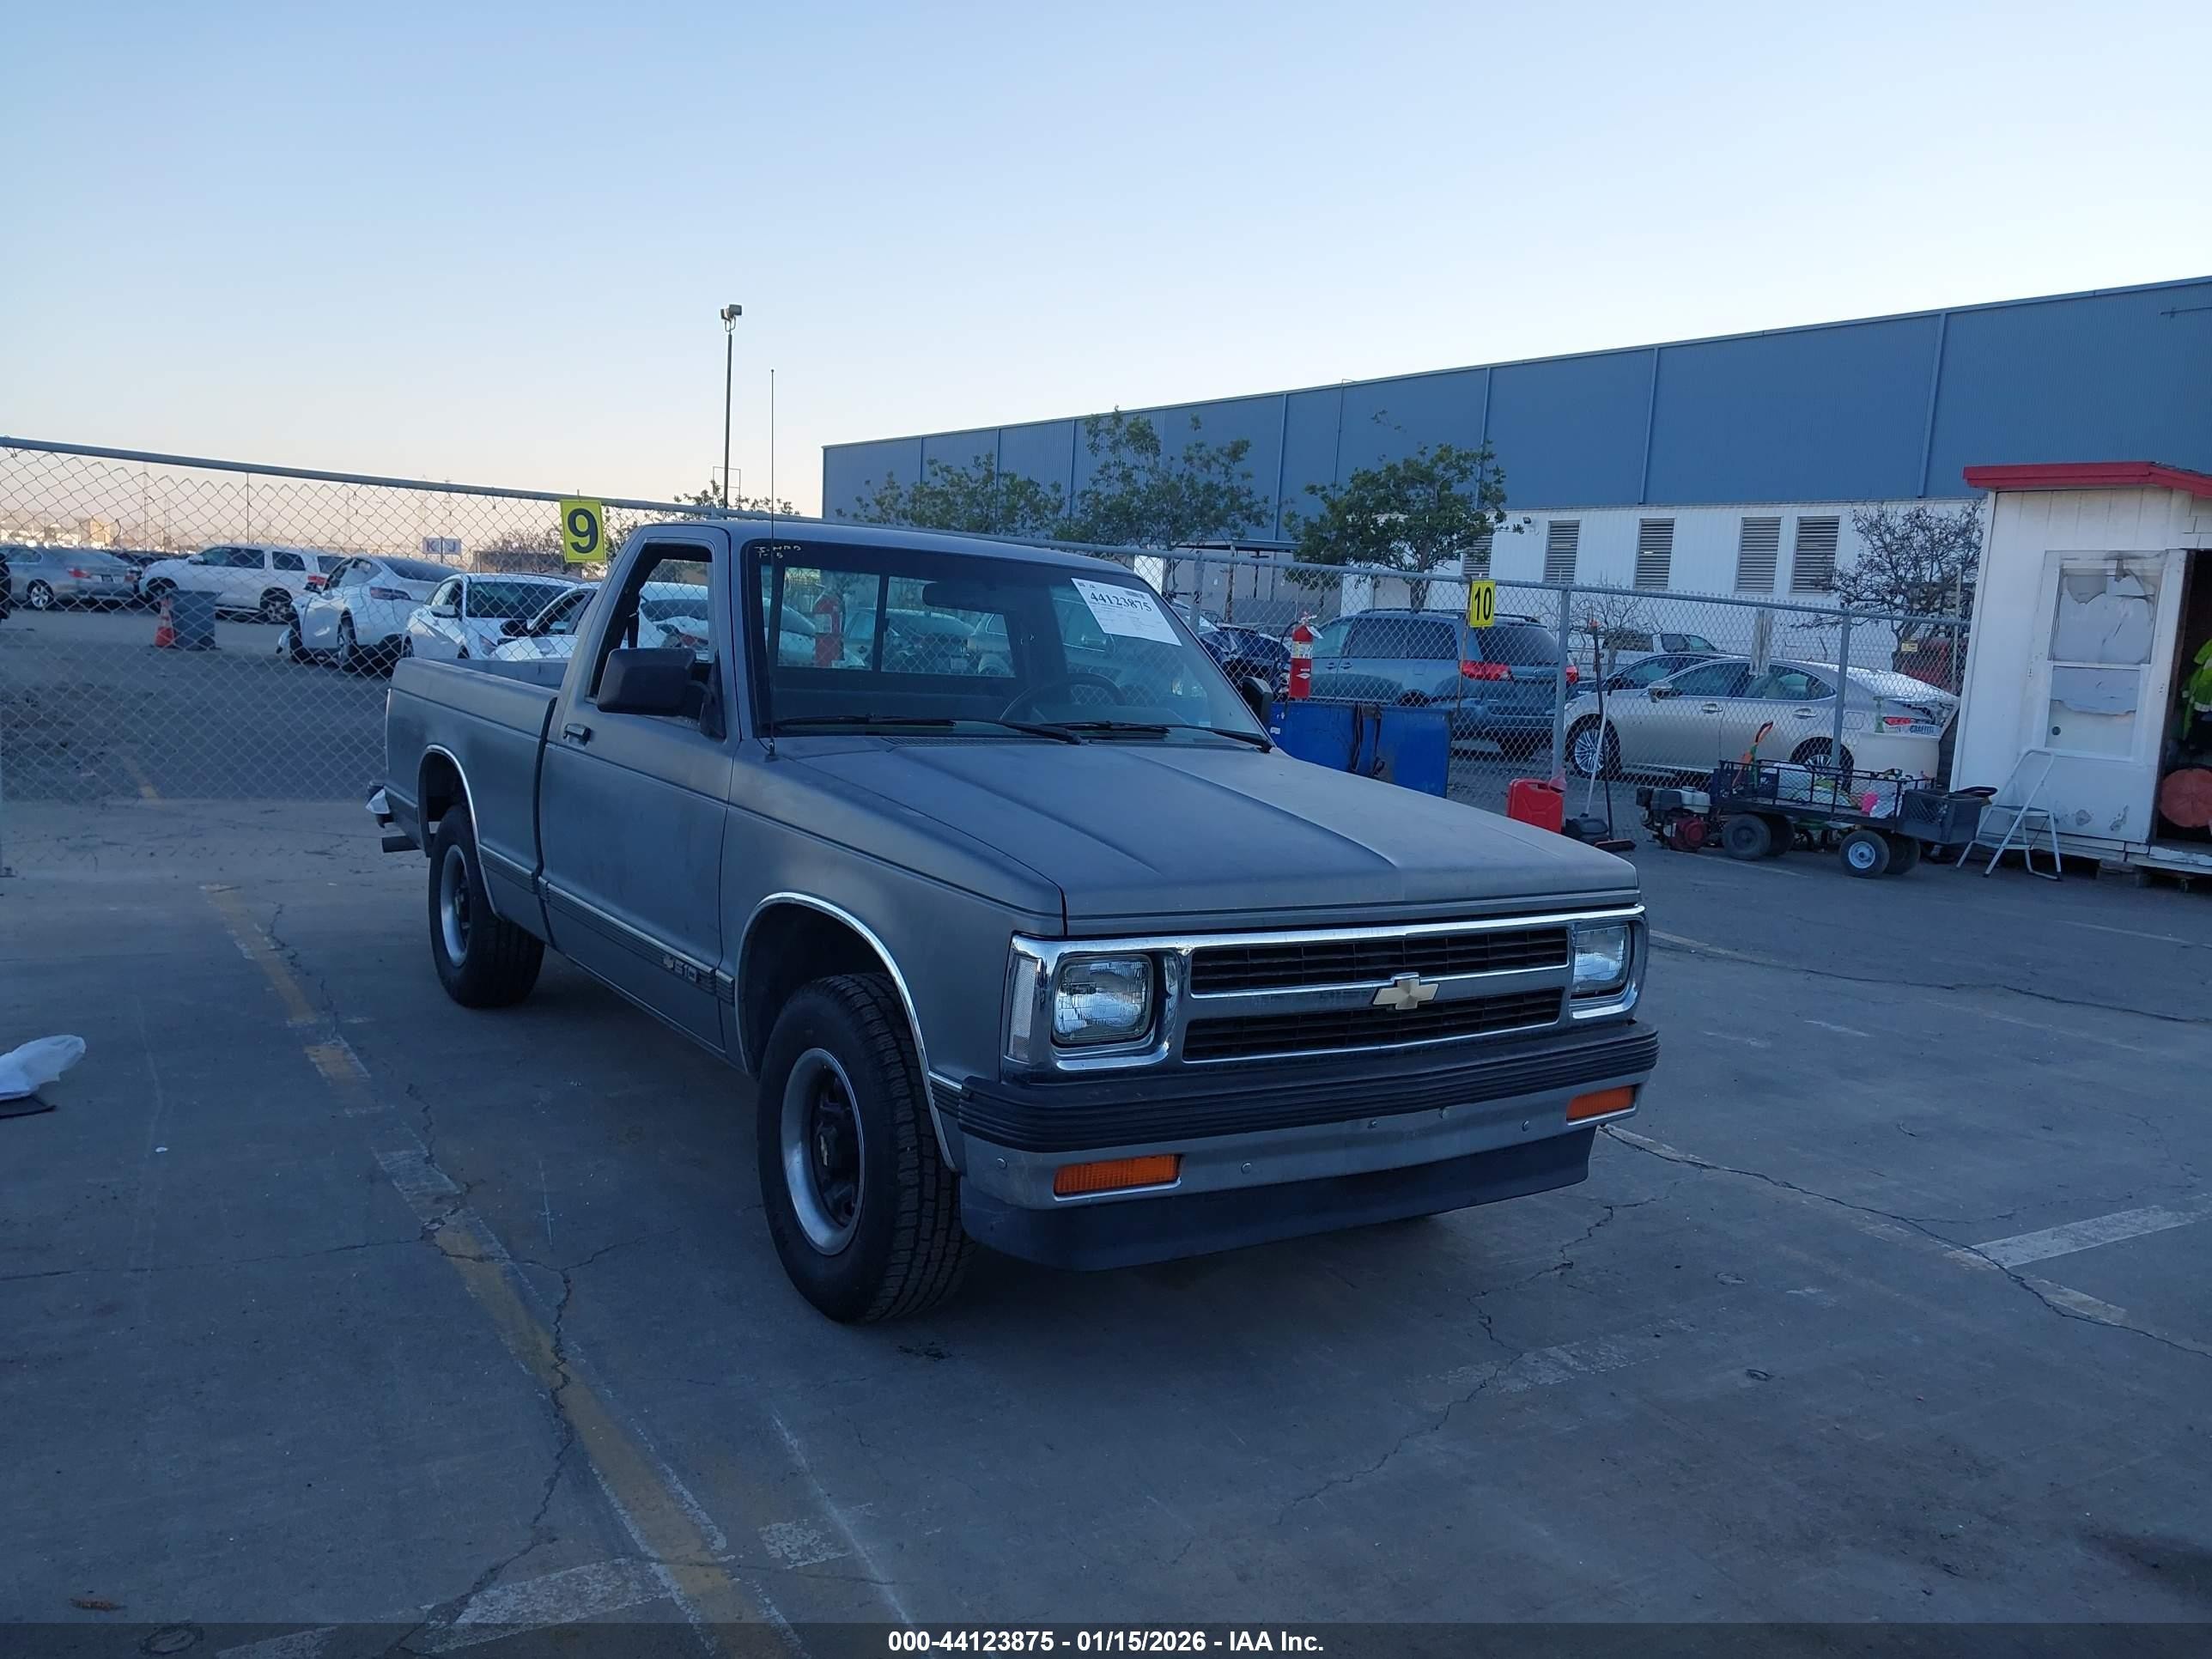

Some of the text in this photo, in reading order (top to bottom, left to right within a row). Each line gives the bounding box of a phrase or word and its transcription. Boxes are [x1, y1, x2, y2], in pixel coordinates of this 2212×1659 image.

[568, 507, 599, 554] 9
[426, 540, 436, 552] K
[1091, 591, 1152, 612] 44123875
[1474, 586, 1492, 621] 10
